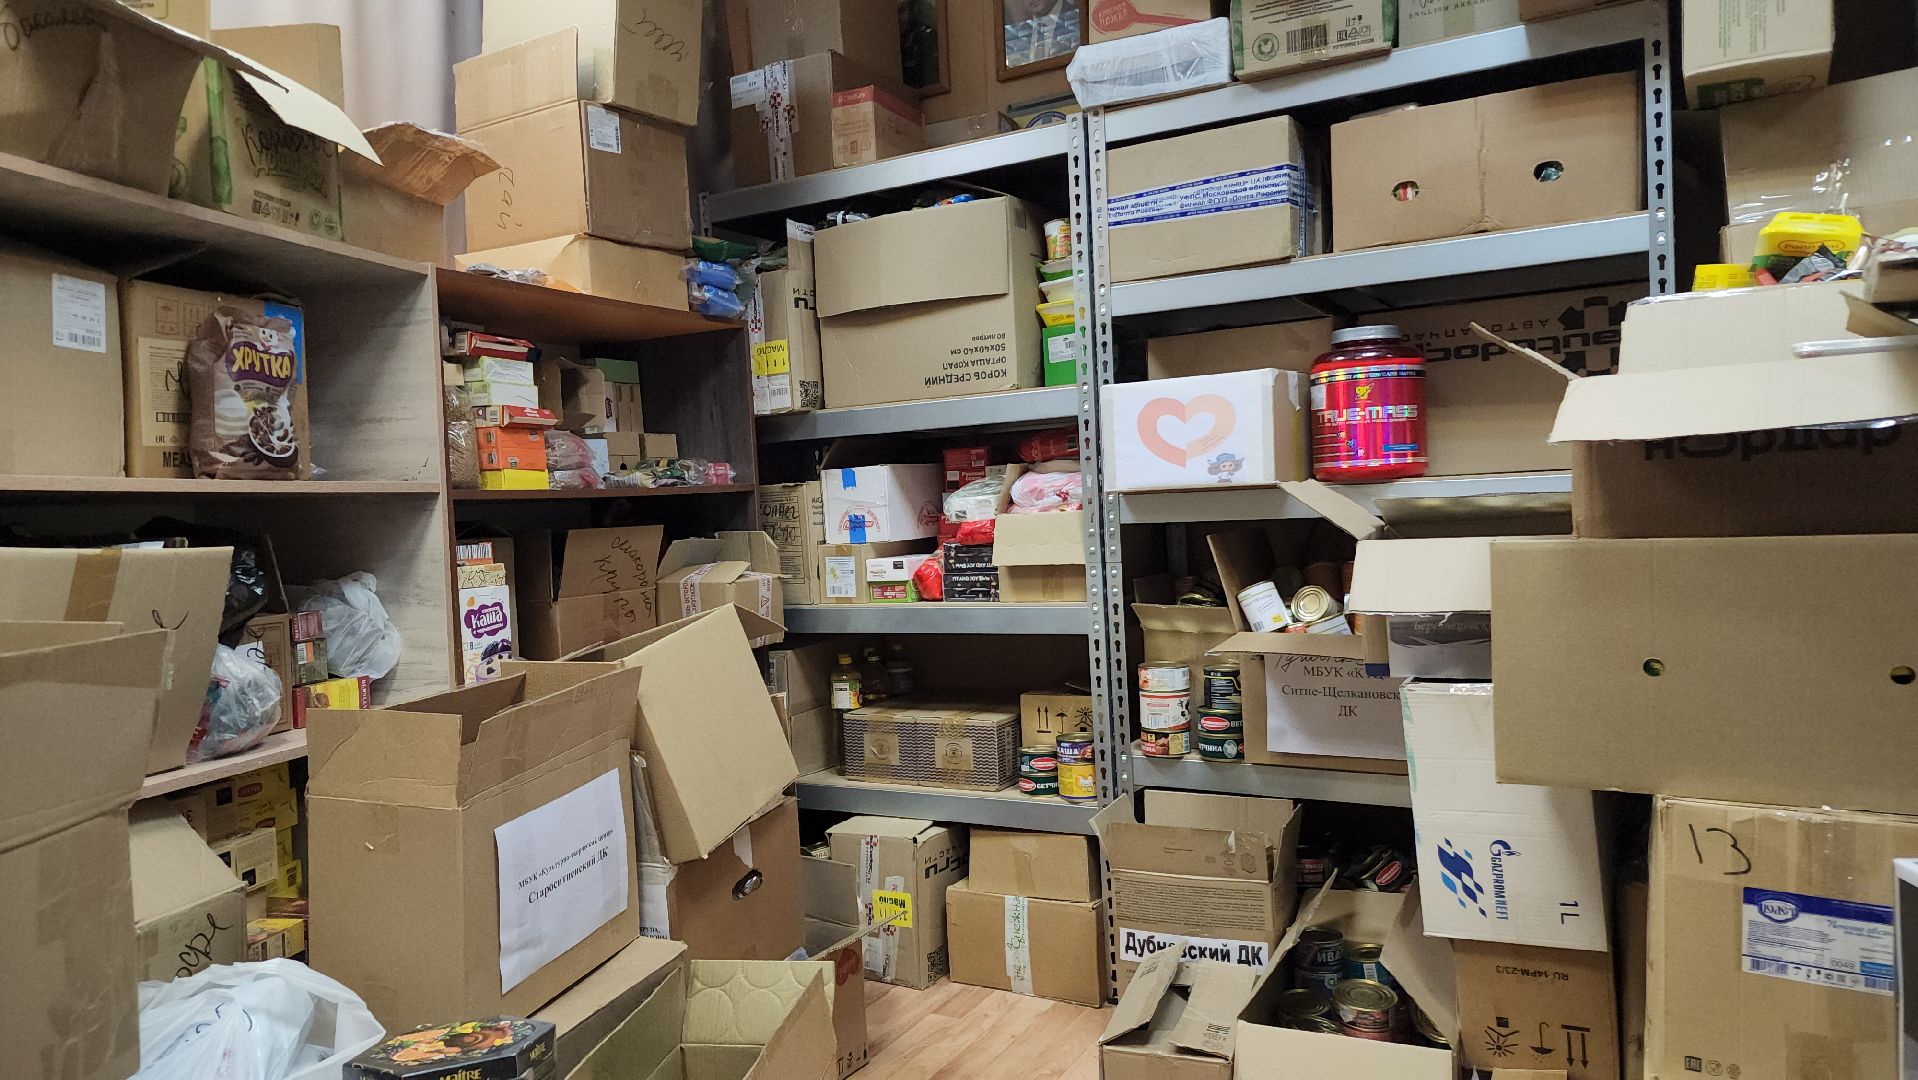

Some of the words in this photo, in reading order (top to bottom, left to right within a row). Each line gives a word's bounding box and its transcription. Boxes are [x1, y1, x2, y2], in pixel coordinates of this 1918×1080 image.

[971, 334, 996, 342] литров
[997, 332, 1007, 341] 80
[232, 347, 291, 378] ХРУТКА
[970, 356, 1008, 368] ОРТАША
[924, 372, 972, 388] СРЕДНИЙ
[973, 368, 1008, 382] КОРОБ
[1316, 404, 1418, 424] TRUE-MASS
[471, 609, 503, 629] Каша
[1303, 666, 1344, 678] МБУК
[1338, 705, 1358, 717] ДК
[596, 846, 609, 865] ДК
[1688, 823, 1752, 876] 13
[517, 872, 539, 891] МБУК
[1490, 856, 1509, 921] GAZPROMNEFT
[879, 896, 906, 909] Масло
[1237, 944, 1264, 968] ДК
[1553, 971, 1569, 981] RU
